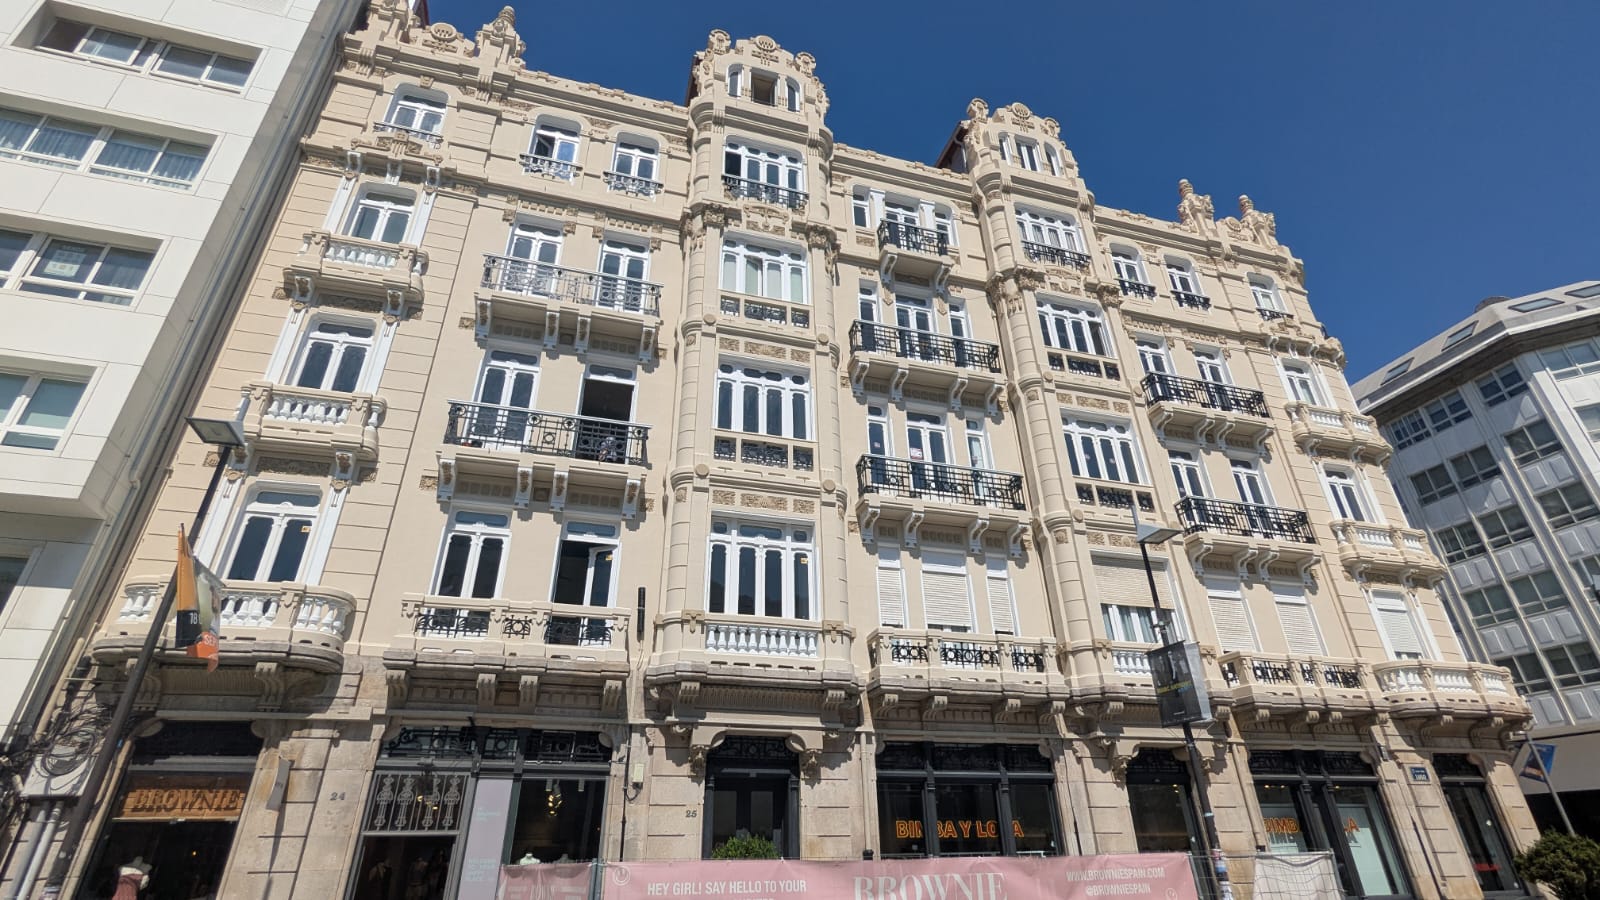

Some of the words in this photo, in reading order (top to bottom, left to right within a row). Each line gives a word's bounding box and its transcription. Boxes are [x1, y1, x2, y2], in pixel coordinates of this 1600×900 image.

[131, 789, 241, 812] BROWNIE
[330, 791, 346, 801] 24
[686, 810, 697, 818] 25
[959, 820, 972, 838] Y
[976, 820, 1025, 838] LOA
[1065, 867, 1166, 882] WWW.BROWNIESPAIN.COM
[647, 882, 669, 896] HEY
[673, 882, 702, 896] GIRL!
[705, 881, 726, 895] SAY
[729, 880, 762, 894] HELLO
[764, 880, 777, 893] TO
[780, 879, 807, 893] YOUR
[853, 872, 1008, 900] BROWNIE
[1085, 883, 1152, 896] @BROWNIESPAIN
